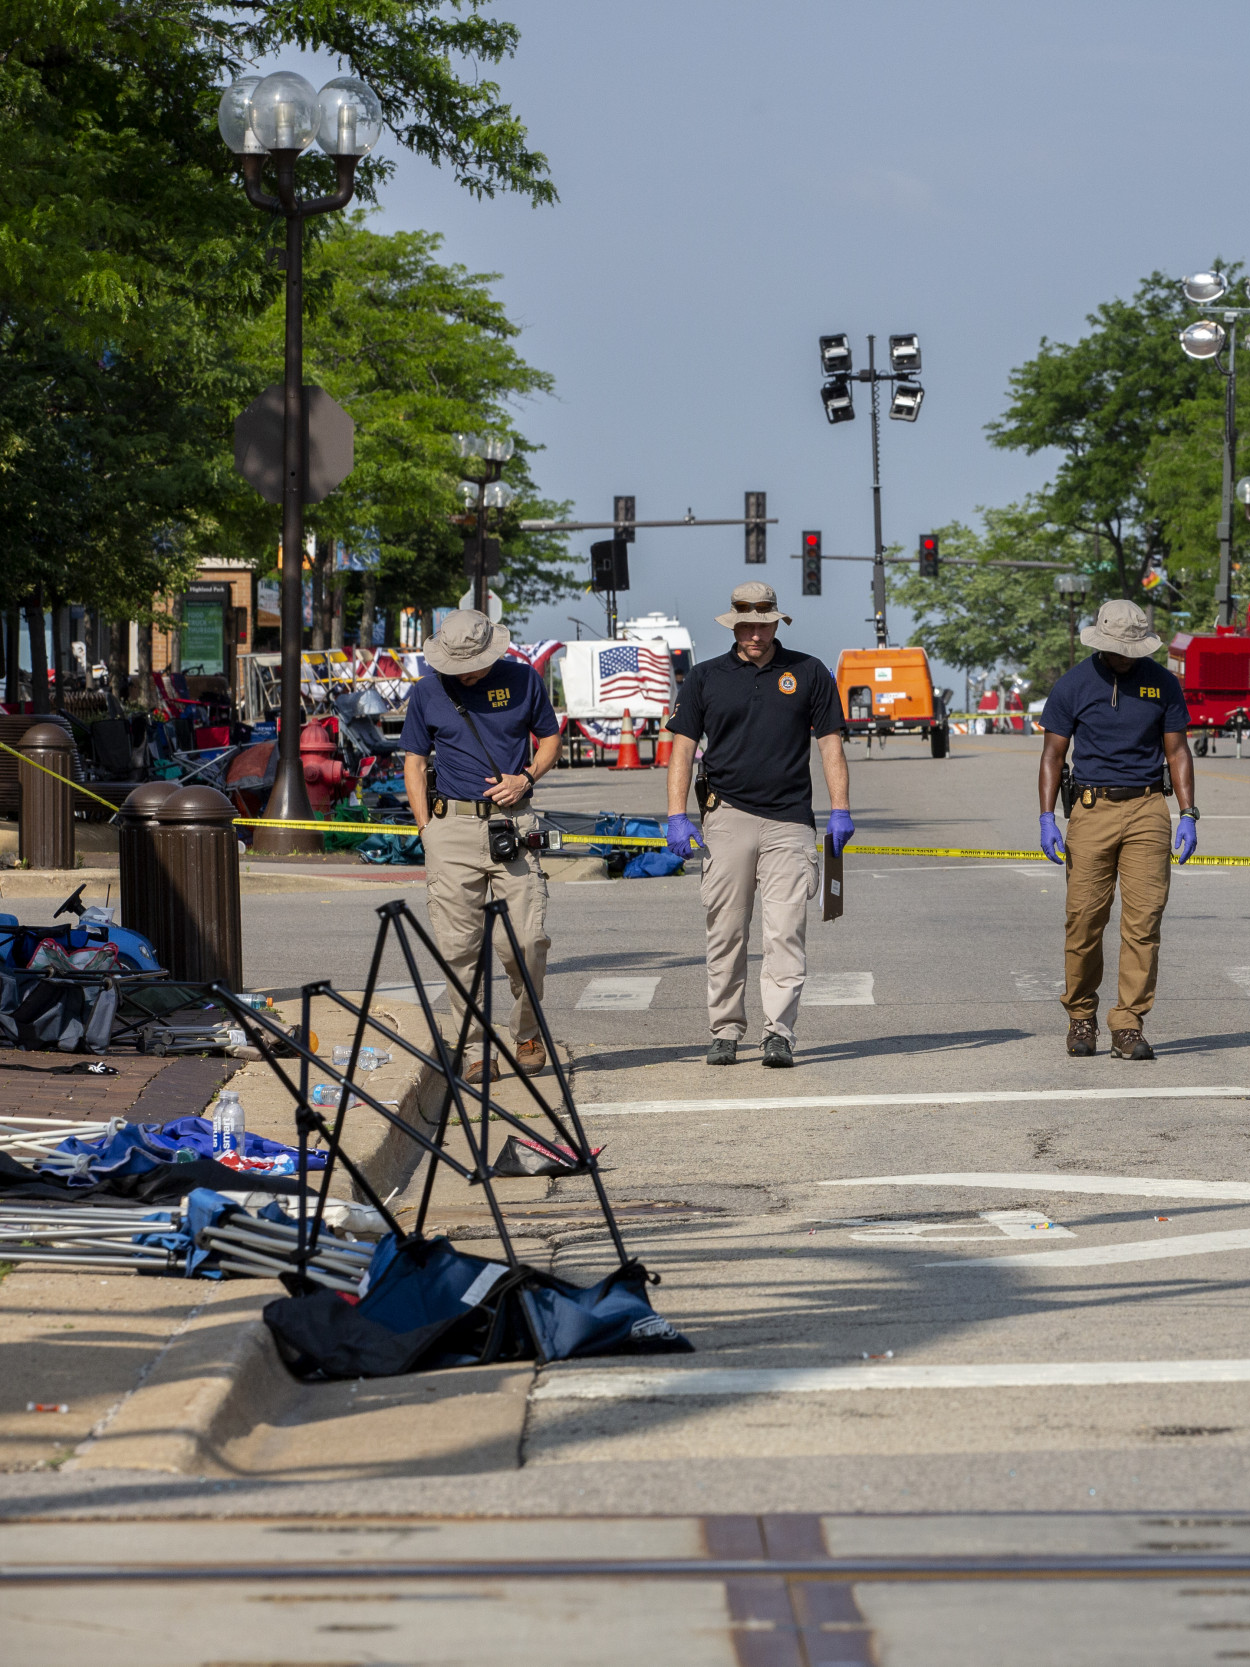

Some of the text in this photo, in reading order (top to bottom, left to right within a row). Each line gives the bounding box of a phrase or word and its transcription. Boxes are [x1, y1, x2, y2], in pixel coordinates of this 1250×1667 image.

[190, 586, 213, 594] Highland
[487, 687, 511, 702] FBI
[1140, 686, 1160, 699] FBI
[492, 700, 509, 708] ERT
[222, 1117, 231, 1150] smart
